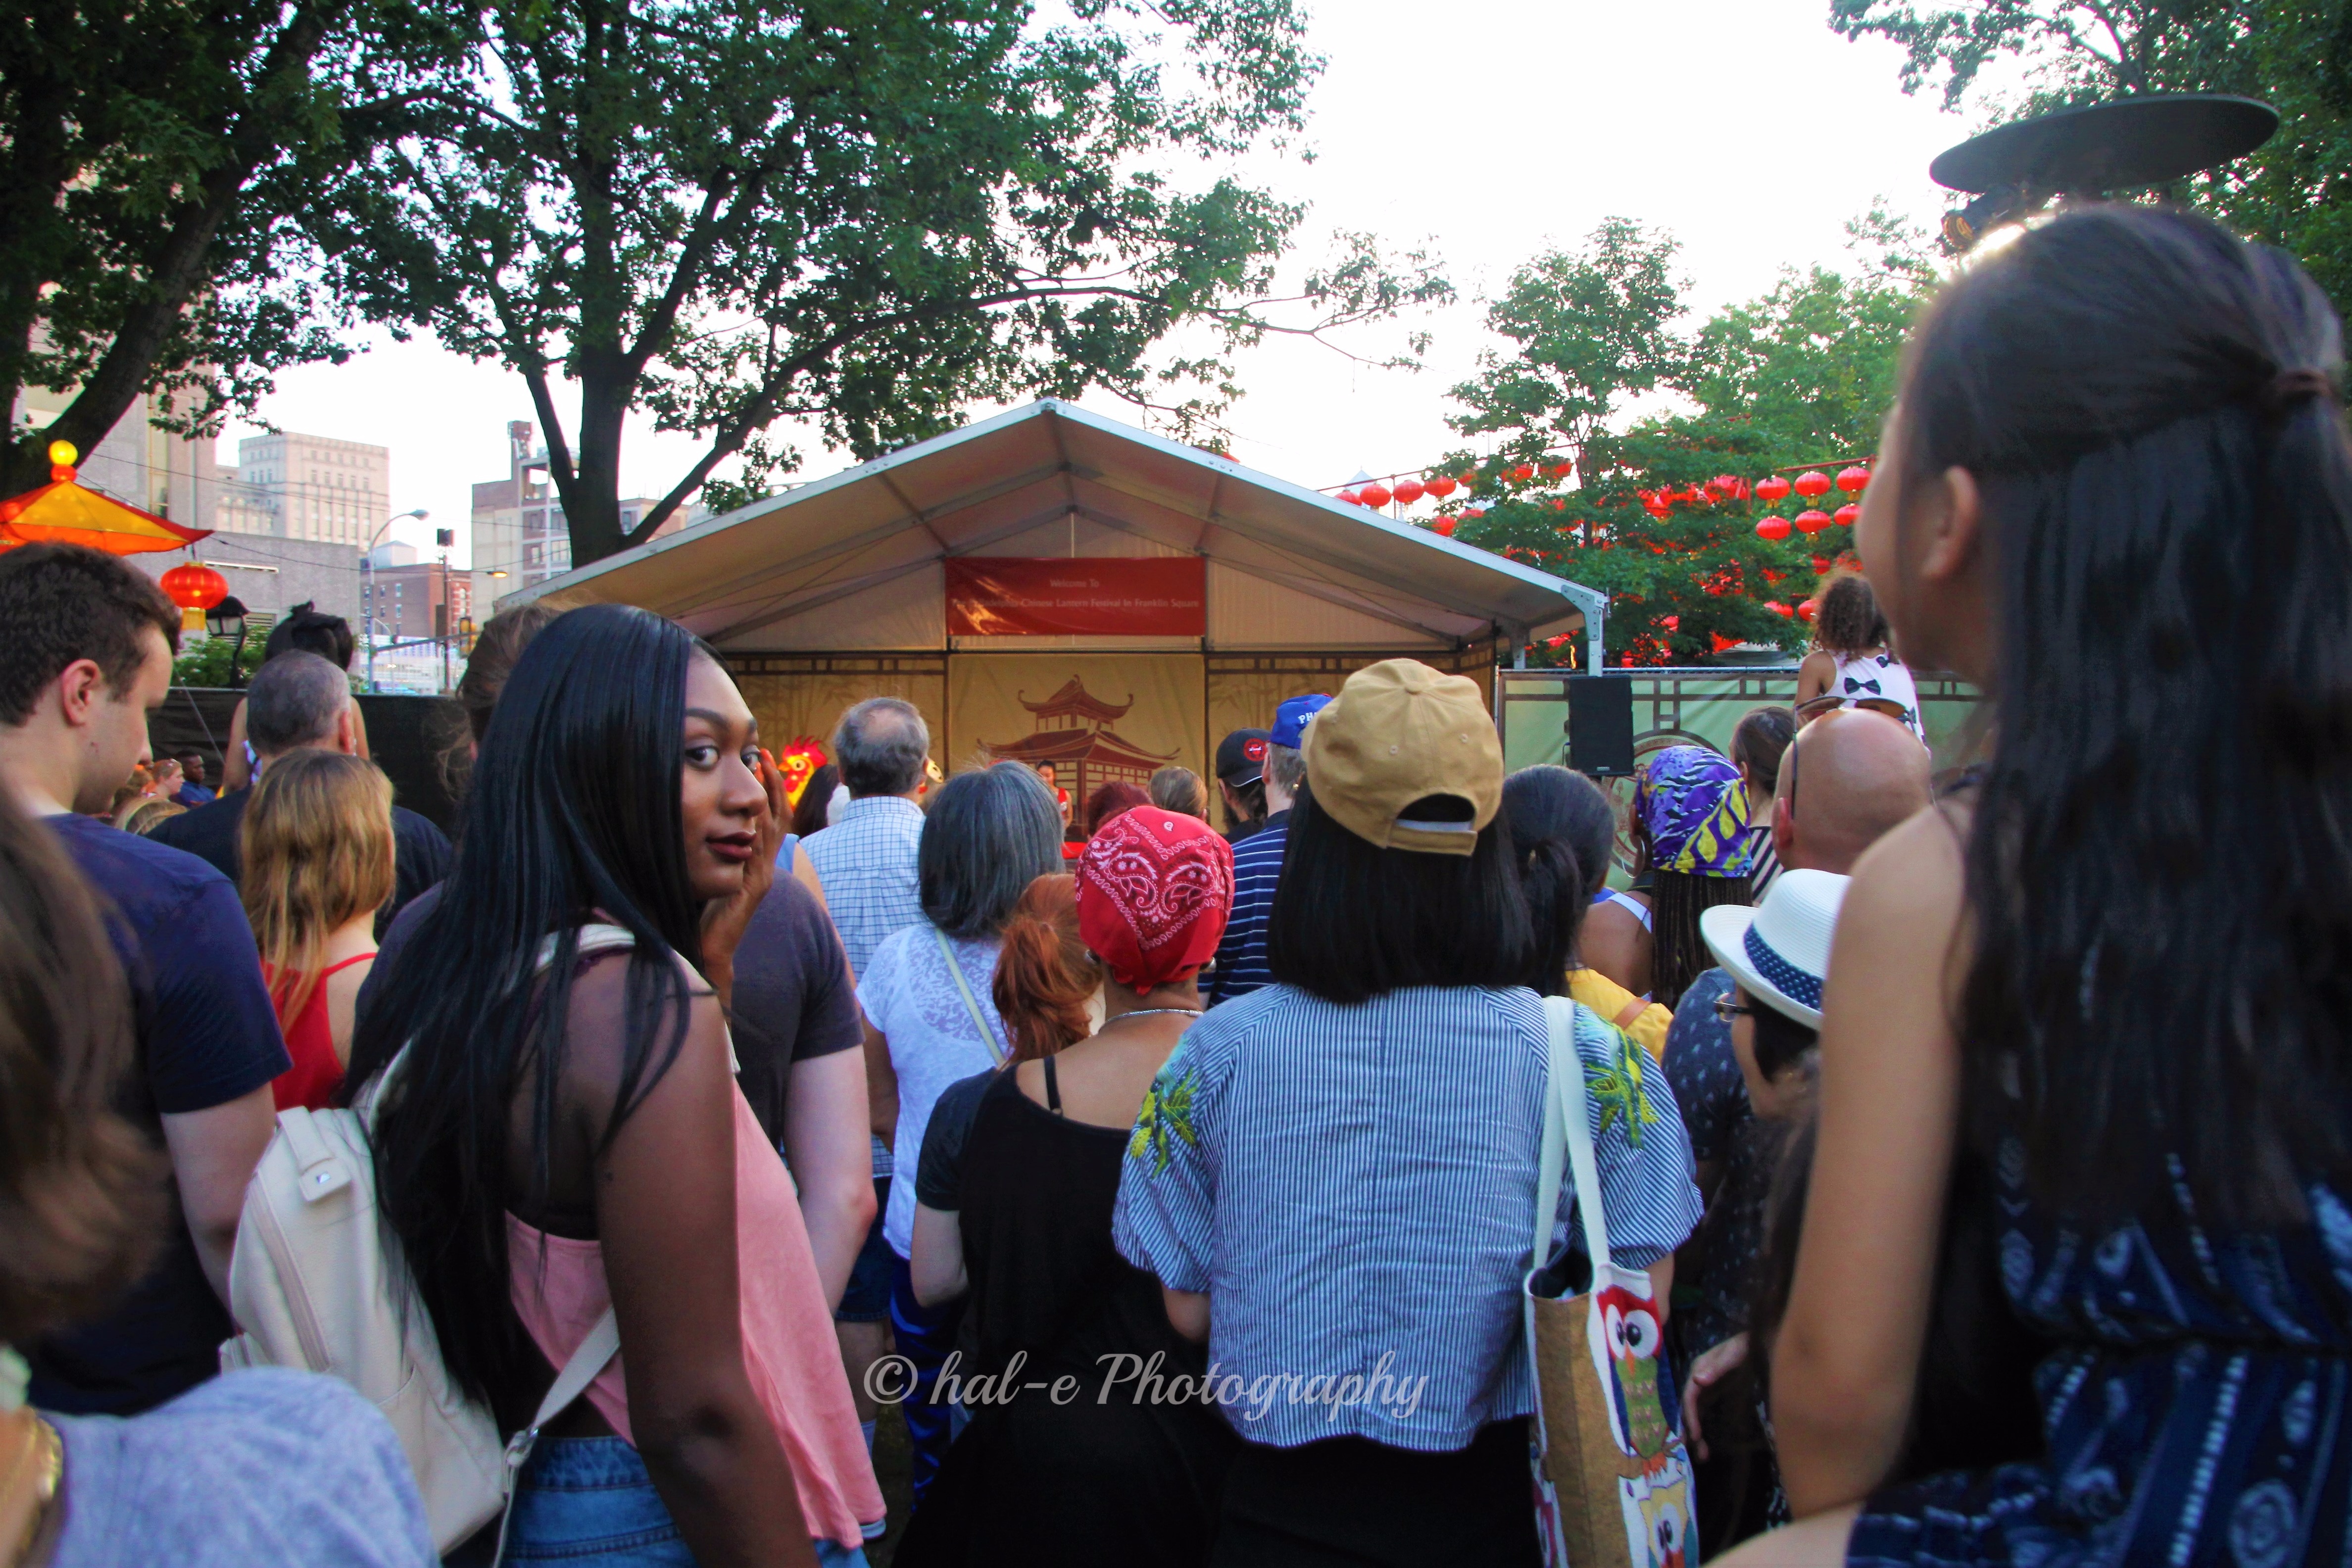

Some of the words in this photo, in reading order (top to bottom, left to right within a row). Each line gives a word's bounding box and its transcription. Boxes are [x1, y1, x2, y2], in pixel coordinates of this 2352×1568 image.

[1050, 578, 1087, 588] Welcome
[1089, 578, 1099, 588] To
[1021, 598, 1054, 607] Chinese
[1056, 598, 1088, 607] Lantern
[1091, 598, 1121, 607] Festival
[1134, 598, 1169, 607] Franklin
[1171, 598, 1199, 608] Square
[1298, 712, 1317, 724] PH
